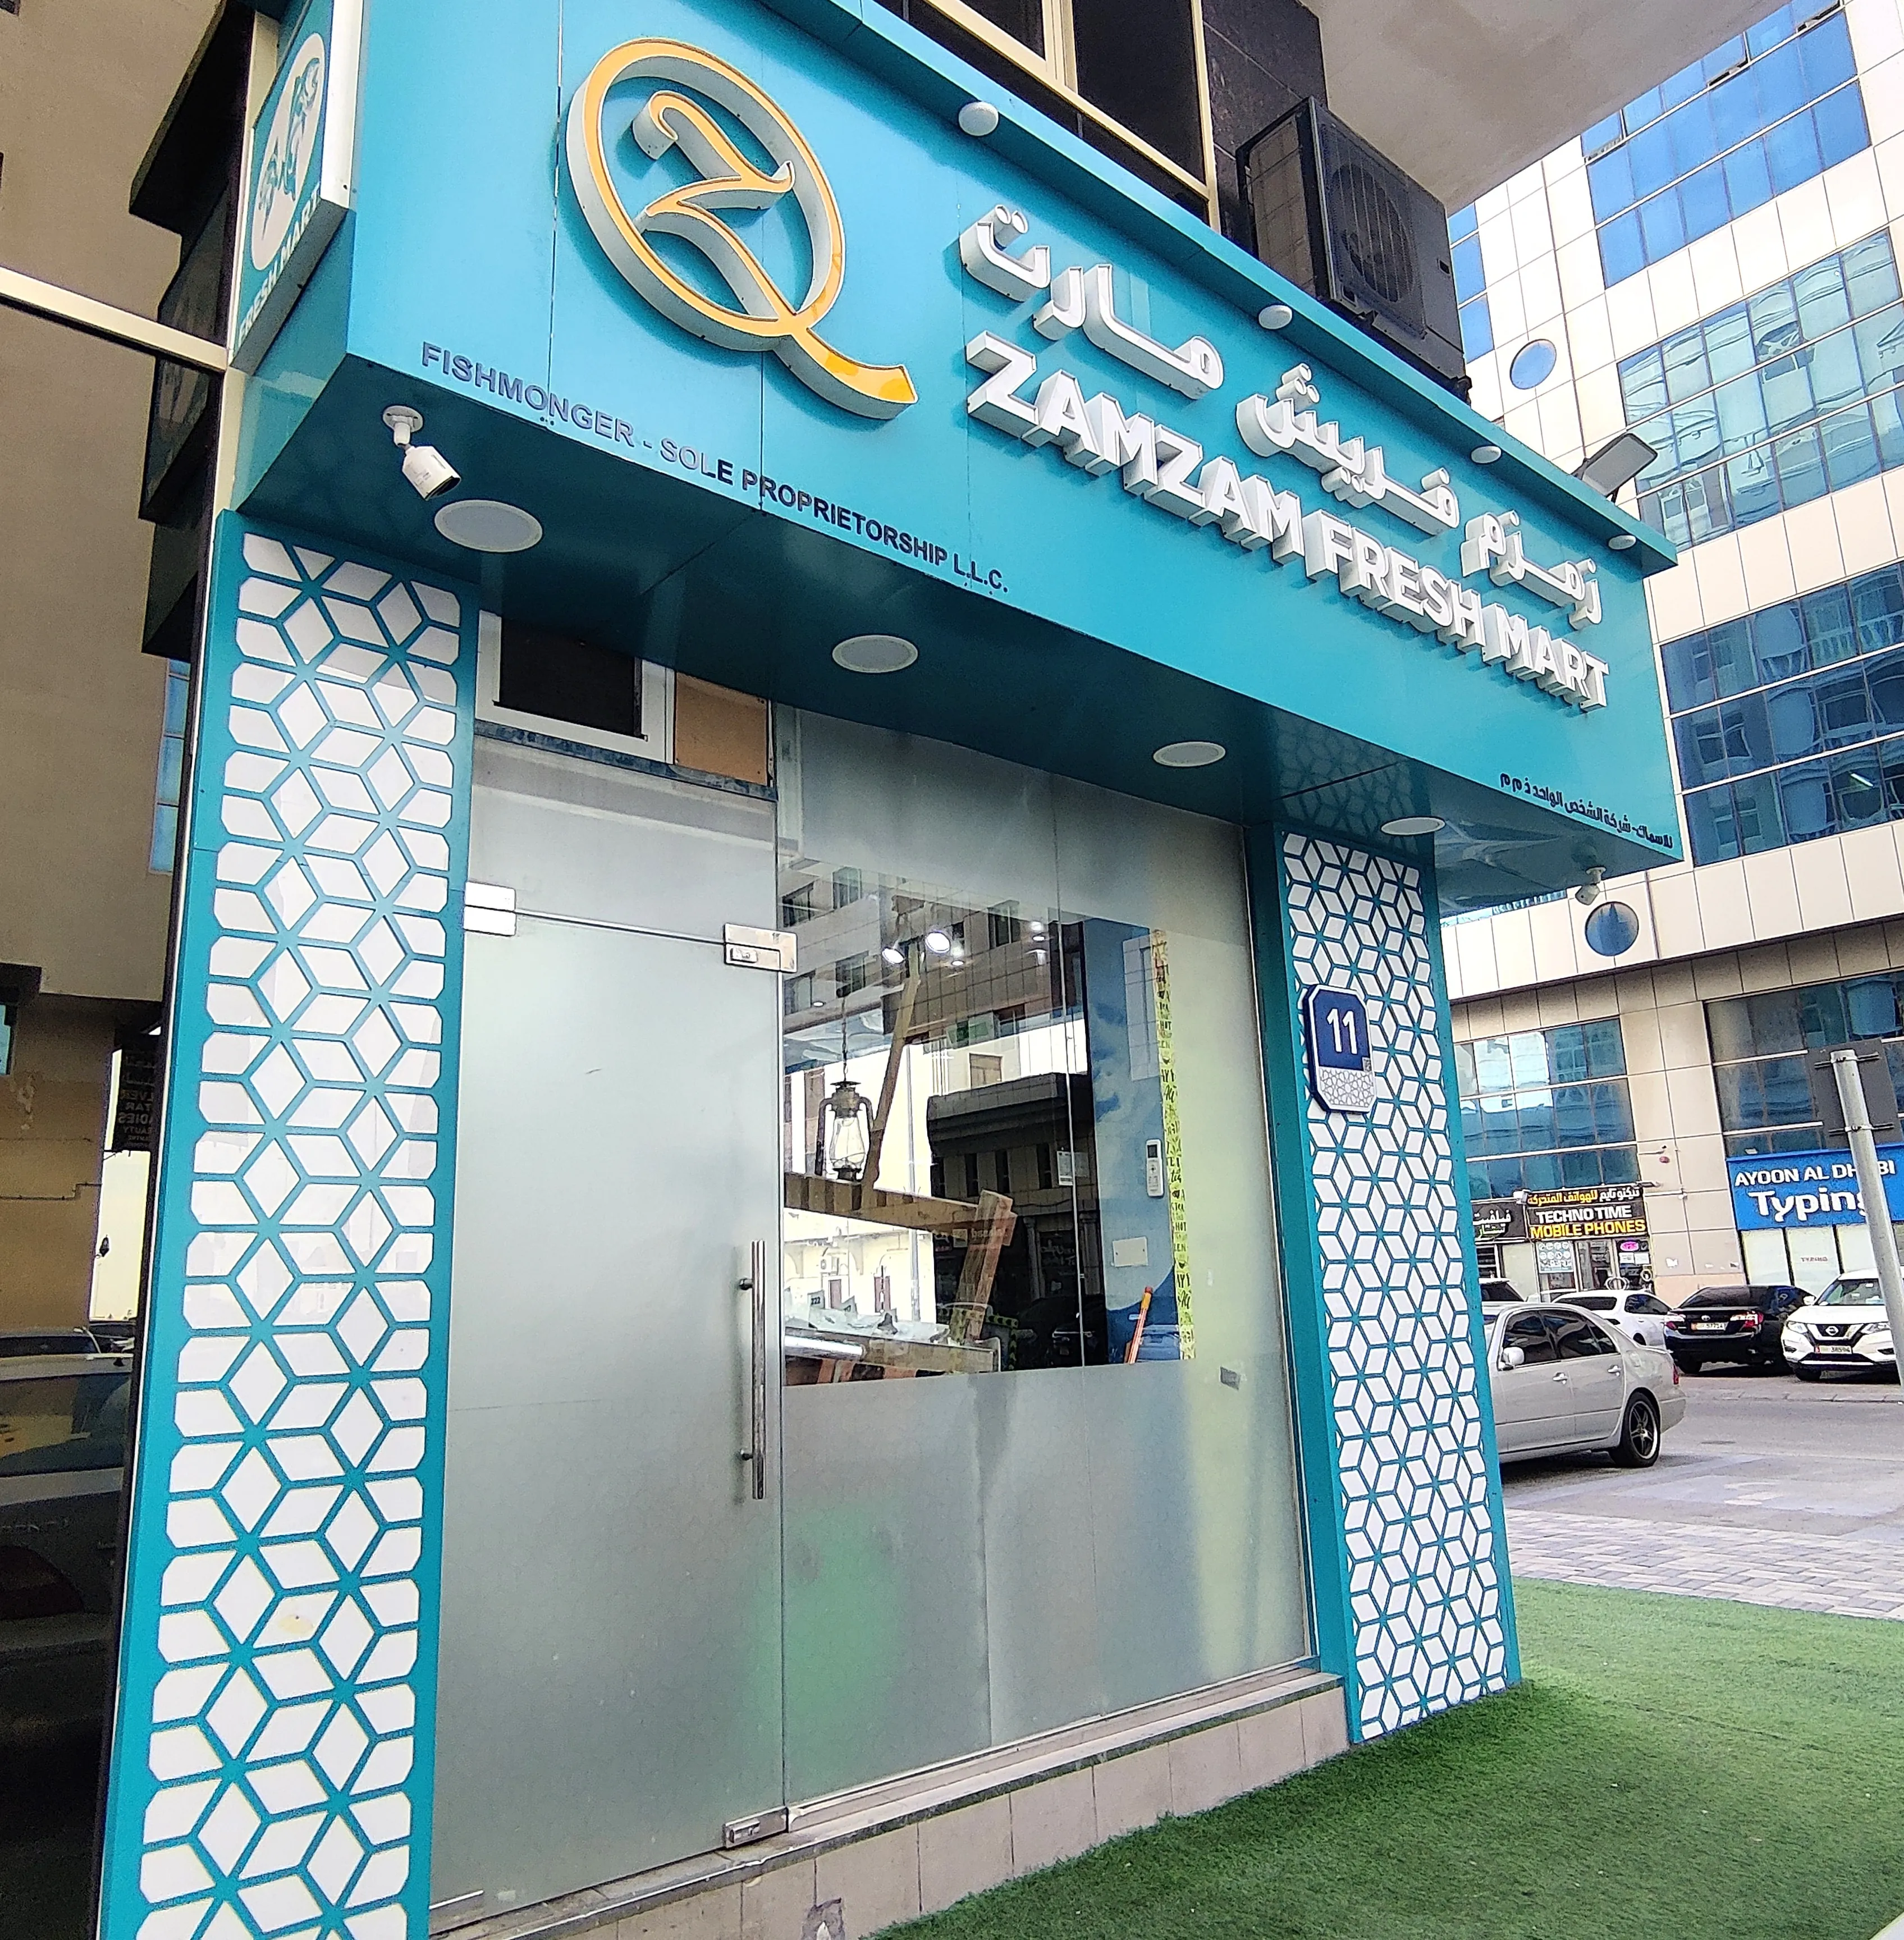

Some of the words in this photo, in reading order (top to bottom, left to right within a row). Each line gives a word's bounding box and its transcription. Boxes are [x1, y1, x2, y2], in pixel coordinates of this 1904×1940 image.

[238, 258, 278, 347] FRESH
[279, 182, 321, 273] MART
[959, 204, 1224, 399] مارت
[422, 341, 634, 447] FISHMONGER
[660, 437, 734, 485] SOLE
[742, 468, 948, 566] PROPRIETORSHIP
[953, 553, 1009, 593] L.L.C.
[1237, 363, 1460, 533] فريش
[967, 331, 1305, 563] ZAMZAM
[1303, 509, 1486, 651] FRESH
[1482, 603, 1609, 712] MART
[1462, 511, 1601, 628] زمزم
[1326, 1008, 1358, 1055] 11
[1530, 1224, 1582, 1239] MOBILE
[1584, 1219, 1646, 1235] PHONES
[1535, 1207, 1594, 1224] TECHNO
[1594, 1205, 1632, 1220] TIME
[1734, 1168, 1799, 1187] AYOON
[1803, 1165, 1829, 1182] AL
[1832, 1160, 1896, 1179] DHBI
